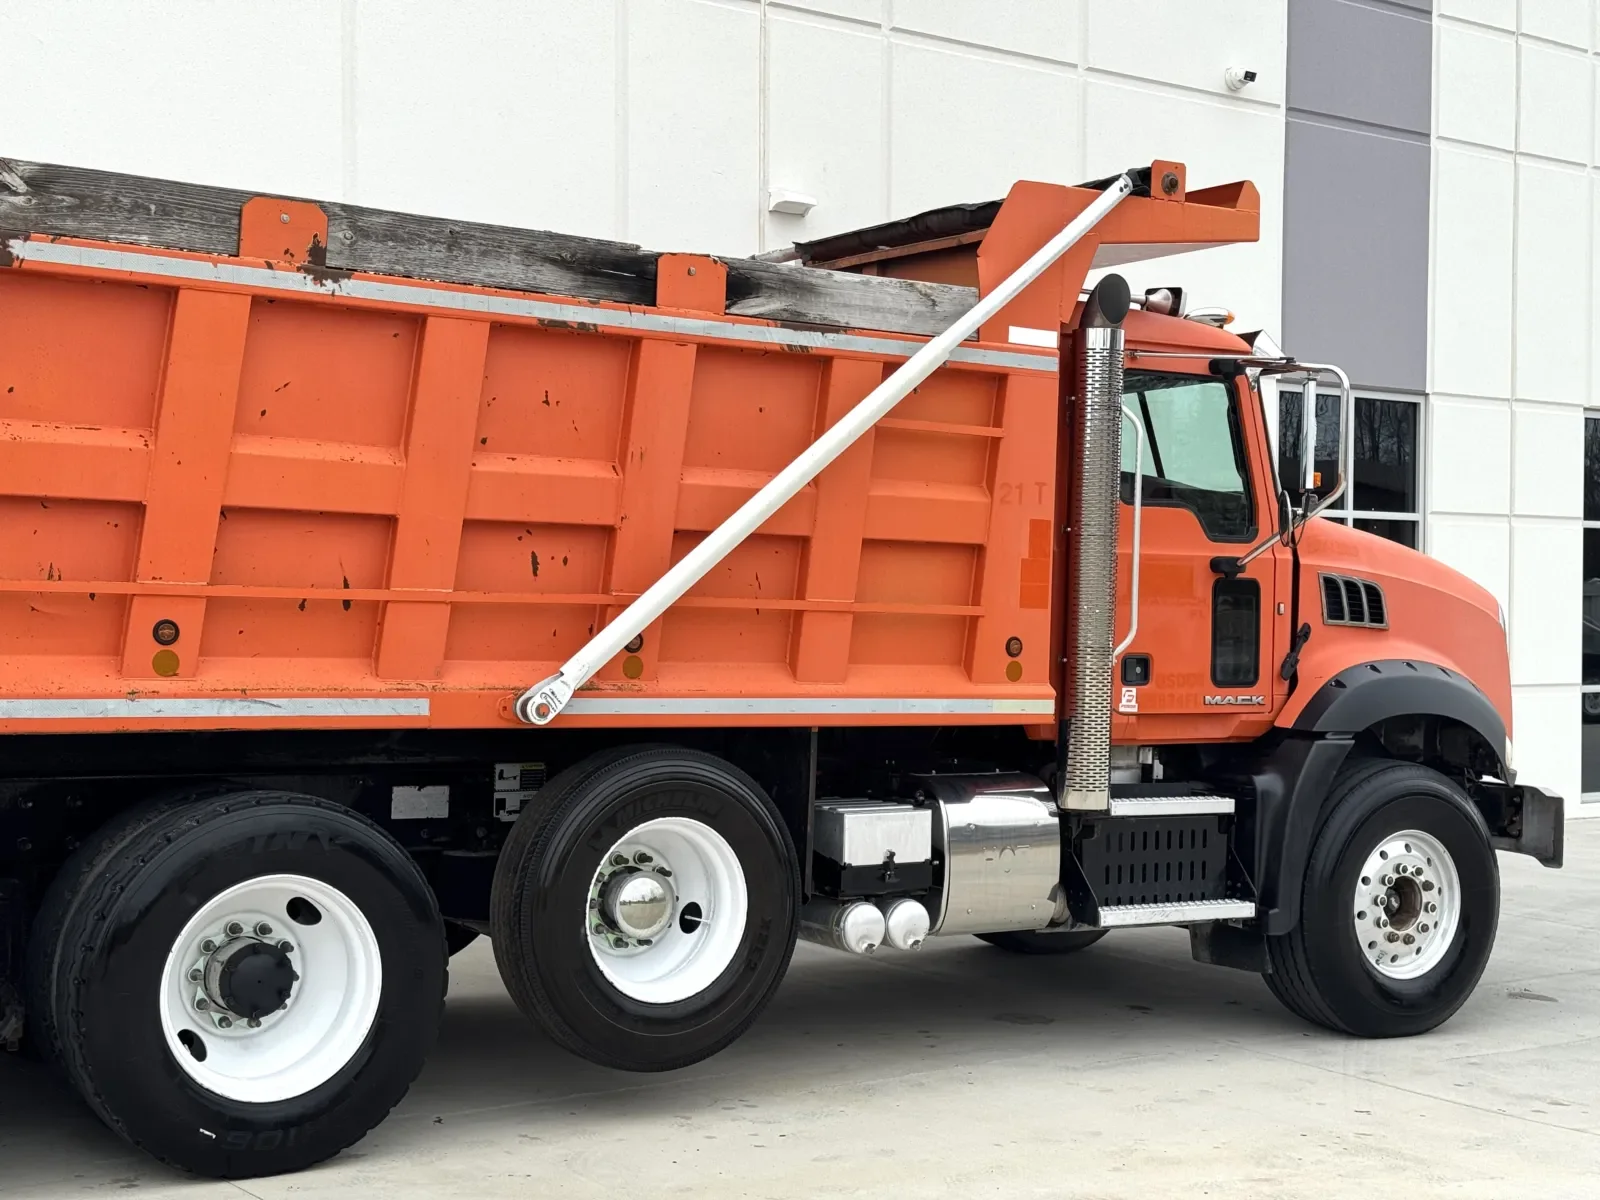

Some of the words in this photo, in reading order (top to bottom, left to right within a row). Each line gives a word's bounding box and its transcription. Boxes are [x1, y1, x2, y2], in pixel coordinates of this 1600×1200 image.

[999, 481, 1024, 506] 21
[1034, 481, 1049, 505] T
[1204, 695, 1265, 706] MACK
